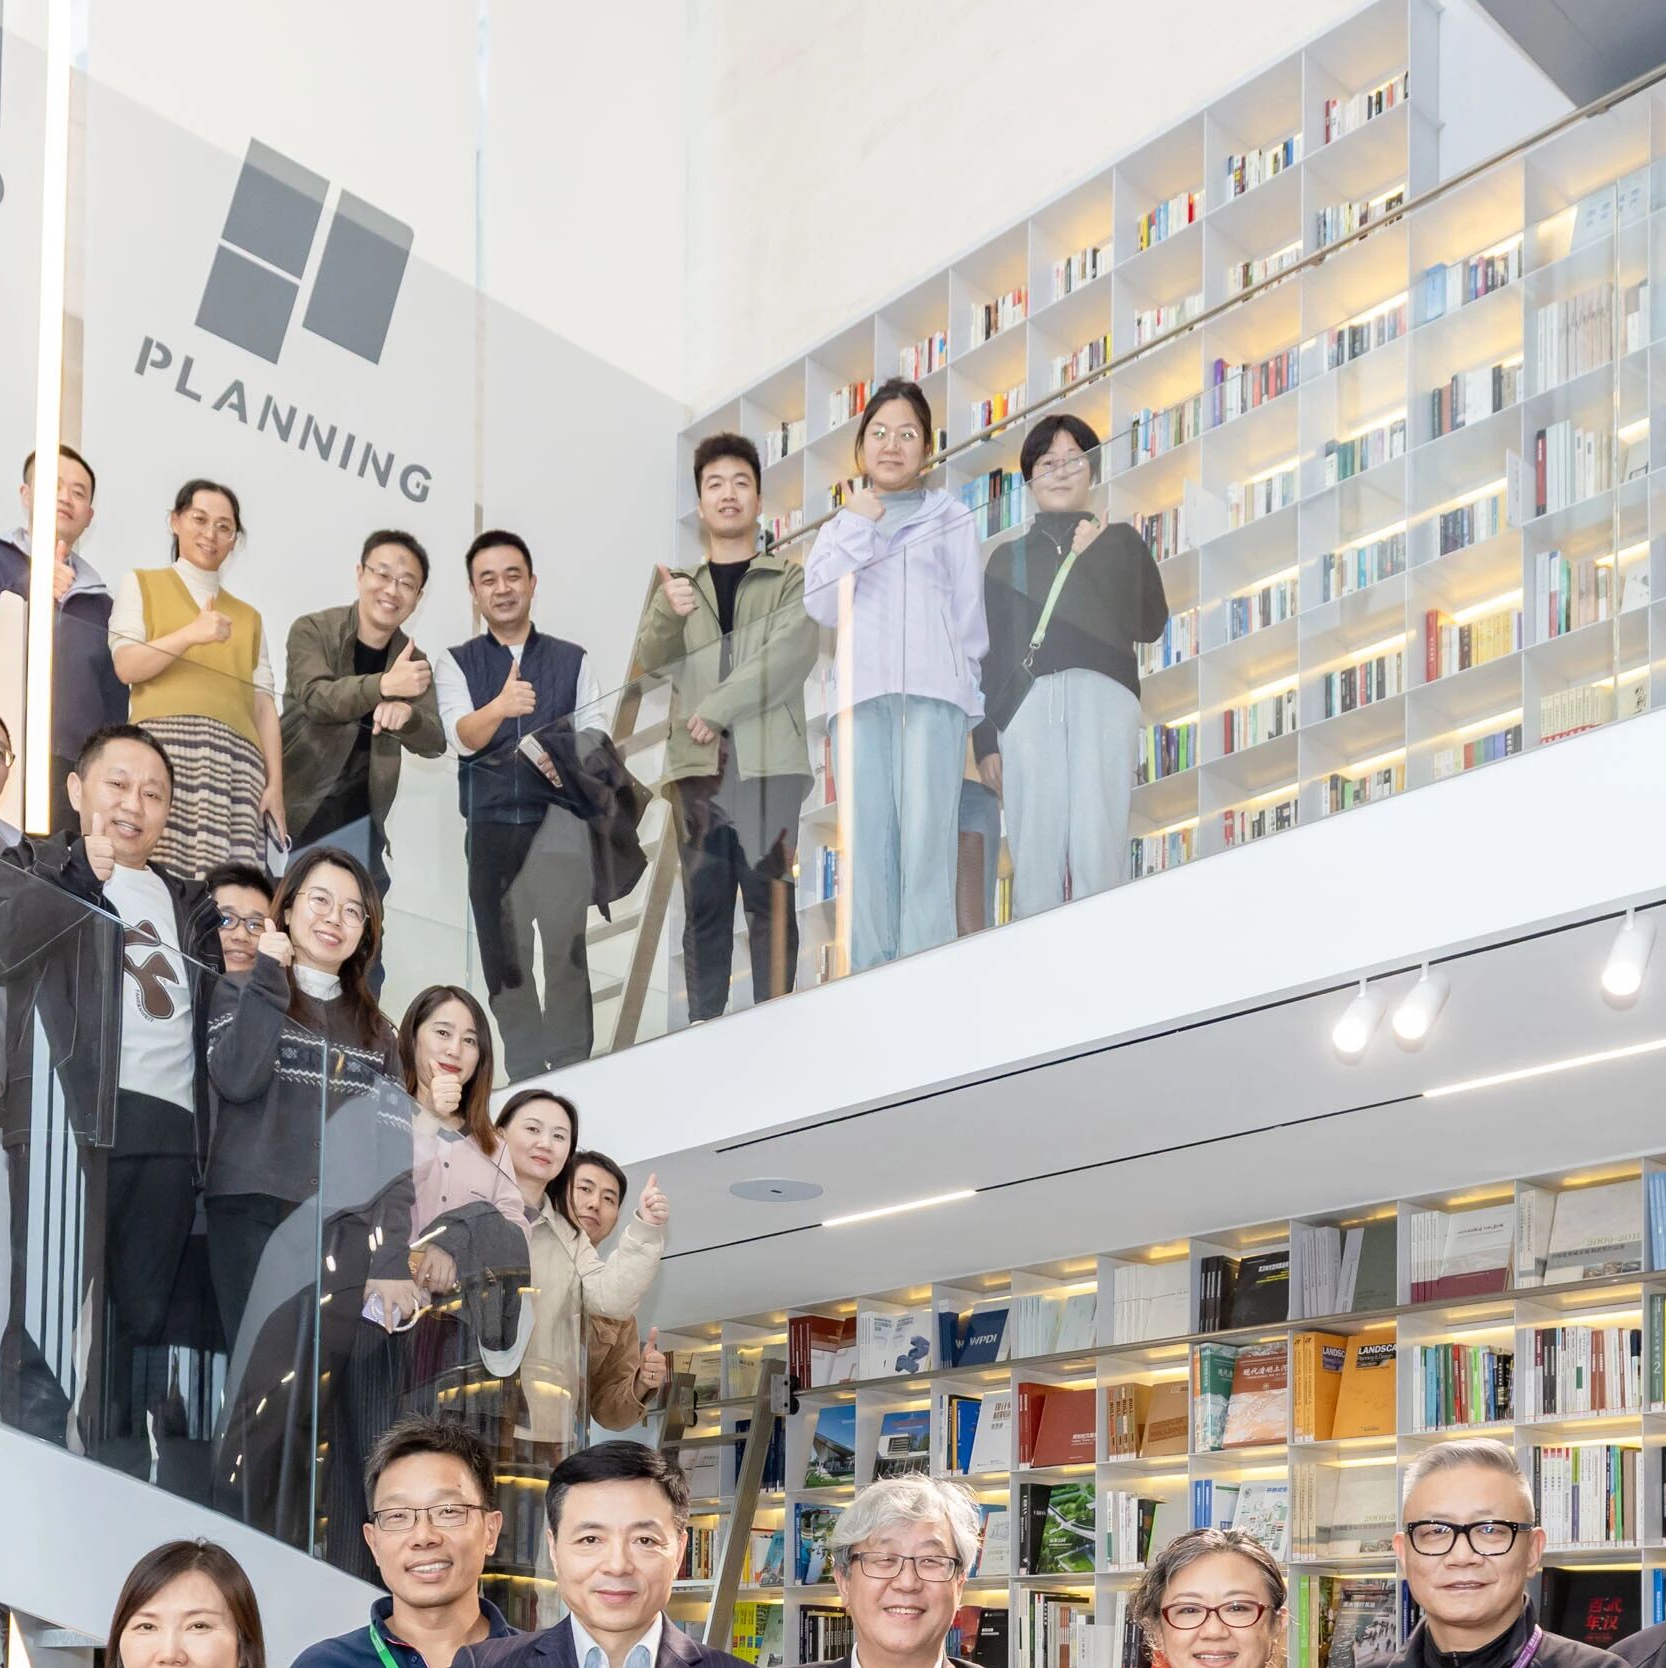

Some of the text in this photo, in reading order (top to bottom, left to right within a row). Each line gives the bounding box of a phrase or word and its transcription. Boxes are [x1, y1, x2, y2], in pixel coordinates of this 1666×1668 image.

[135, 335, 433, 504] PLANNING
[969, 1333, 998, 1346] WPDI
[1653, 1361, 1661, 1374] 2
